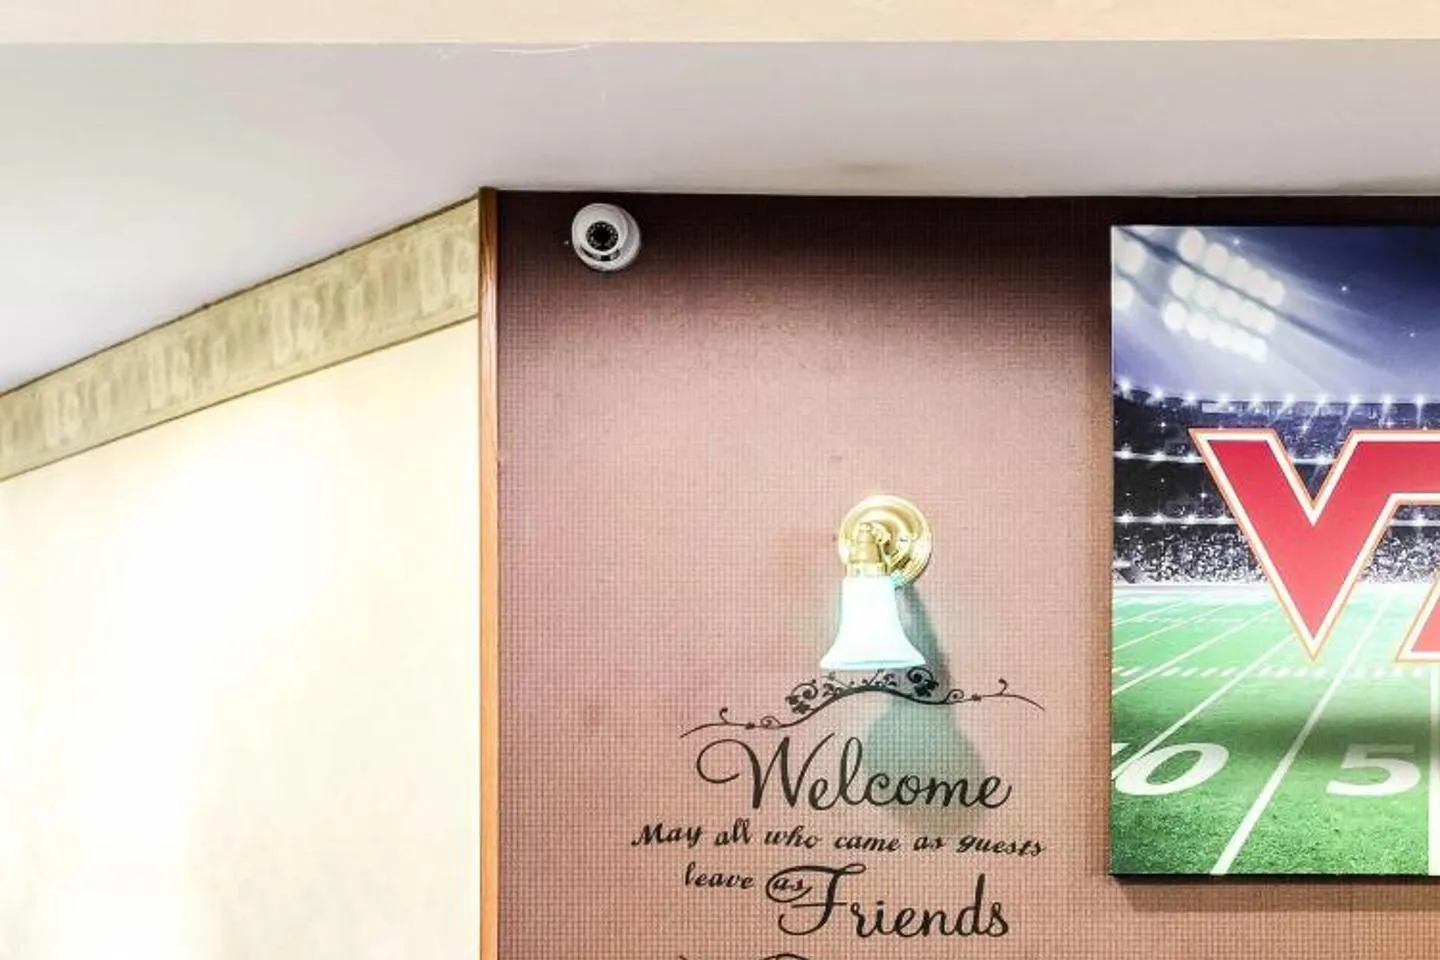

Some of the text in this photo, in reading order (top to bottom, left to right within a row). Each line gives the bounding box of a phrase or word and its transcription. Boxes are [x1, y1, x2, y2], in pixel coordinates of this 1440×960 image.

[696, 733, 1012, 810] Welcome
[1110, 742, 1230, 796] 0
[631, 817, 1046, 857] May all who came as guests
[684, 861, 1009, 938] leave as Friends
